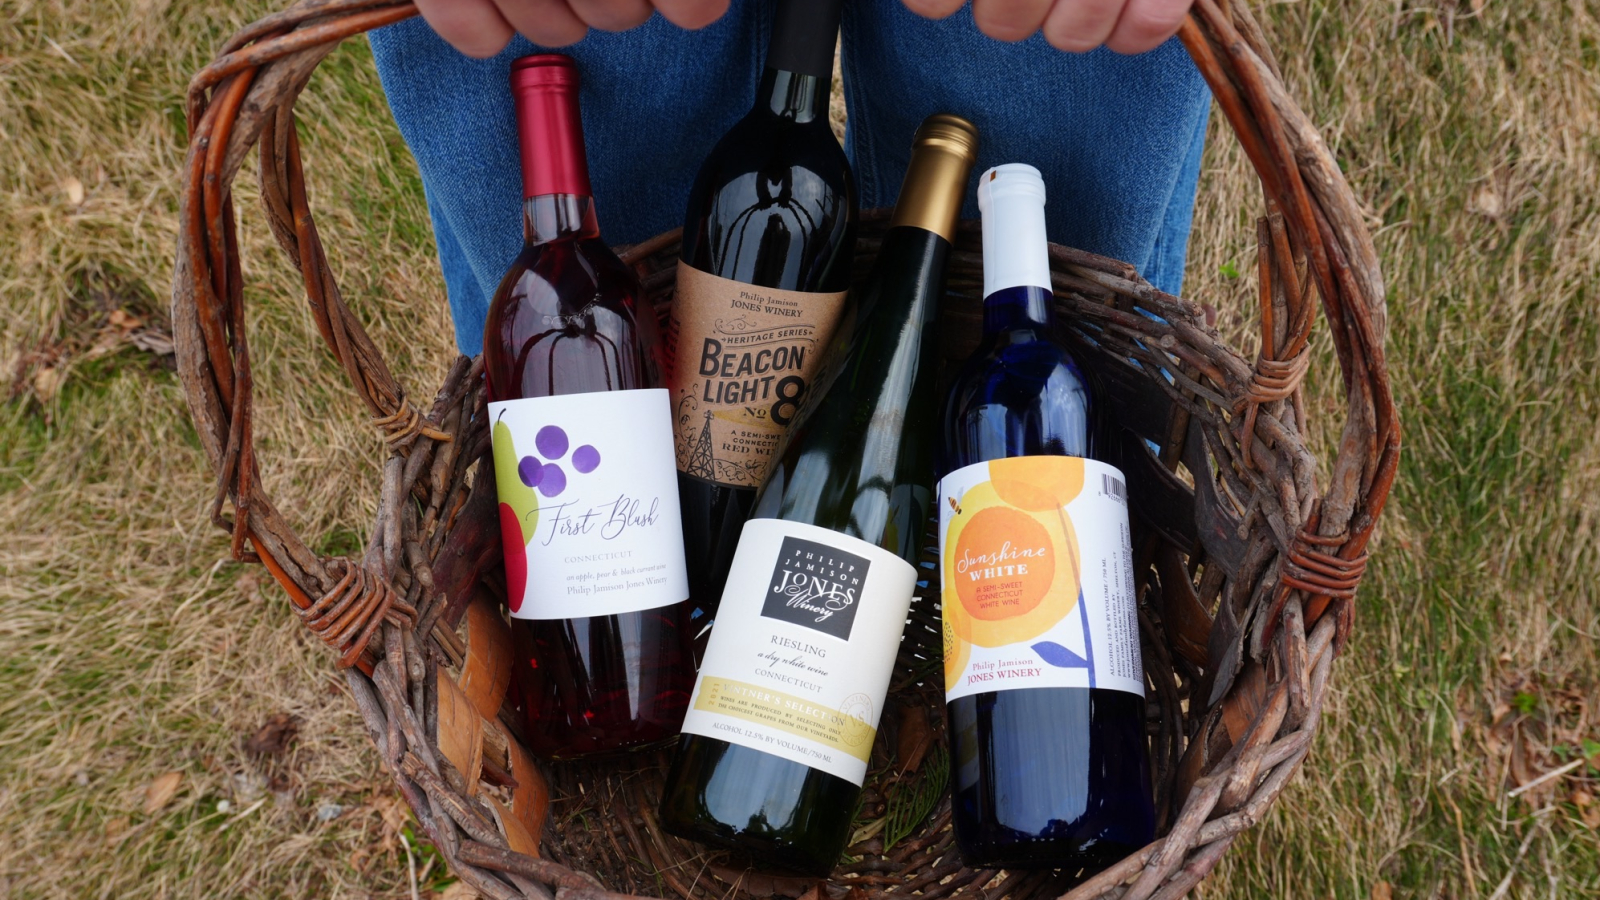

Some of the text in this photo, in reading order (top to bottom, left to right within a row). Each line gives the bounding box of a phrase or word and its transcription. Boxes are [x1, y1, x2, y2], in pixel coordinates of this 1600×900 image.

[730, 299, 803, 318] JONES WINERY
[740, 291, 798, 307] Philip Jamison
[727, 328, 808, 344] HERITAGE SERIES
[699, 337, 806, 378] BEACON
[703, 375, 775, 404] LIGHT
[770, 375, 805, 426] 8
[741, 431, 781, 440] SEMI-SWE
[722, 443, 750, 454] RED
[526, 494, 659, 546] First Blush
[564, 550, 633, 564] CONNECTICUT
[795, 550, 855, 572] PHILIP
[957, 541, 1046, 573] Sunshine
[597, 571, 610, 581] pear
[612, 569, 618, 577] &
[620, 567, 636, 575] black
[785, 559, 859, 586] JAMISON
[969, 564, 1028, 581] WHITE
[567, 576, 668, 596] Philip Jamison Jones Winery
[773, 569, 855, 605] JONES
[977, 590, 1023, 602] CONNECTICUT
[983, 582, 1023, 593] SEMI-SWEET
[784, 584, 848, 623] Winery
[980, 598, 1020, 609] WHITE WINE
[1106, 613, 1111, 622] BY
[771, 635, 827, 658] RIESLING
[765, 651, 780, 667] dry
[782, 655, 806, 669] white
[807, 666, 828, 676] wine
[972, 659, 1033, 671] Philip Jamison
[754, 668, 822, 693] CONNECTICUT
[967, 668, 1042, 686] JONES WINERY
[708, 683, 720, 706] 2021
[723, 684, 781, 706] VINTNER'S
[751, 702, 782, 716] PRODUCED
[796, 716, 826, 730] SELECTING
[755, 711, 777, 722] GRAPES
[778, 718, 795, 728] FROM
[796, 724, 808, 733] OUR
[712, 722, 743, 735] ALCOHOL
[744, 729, 764, 741] 12.5%
[765, 735, 776, 744] BY
[823, 755, 833, 763] ML
